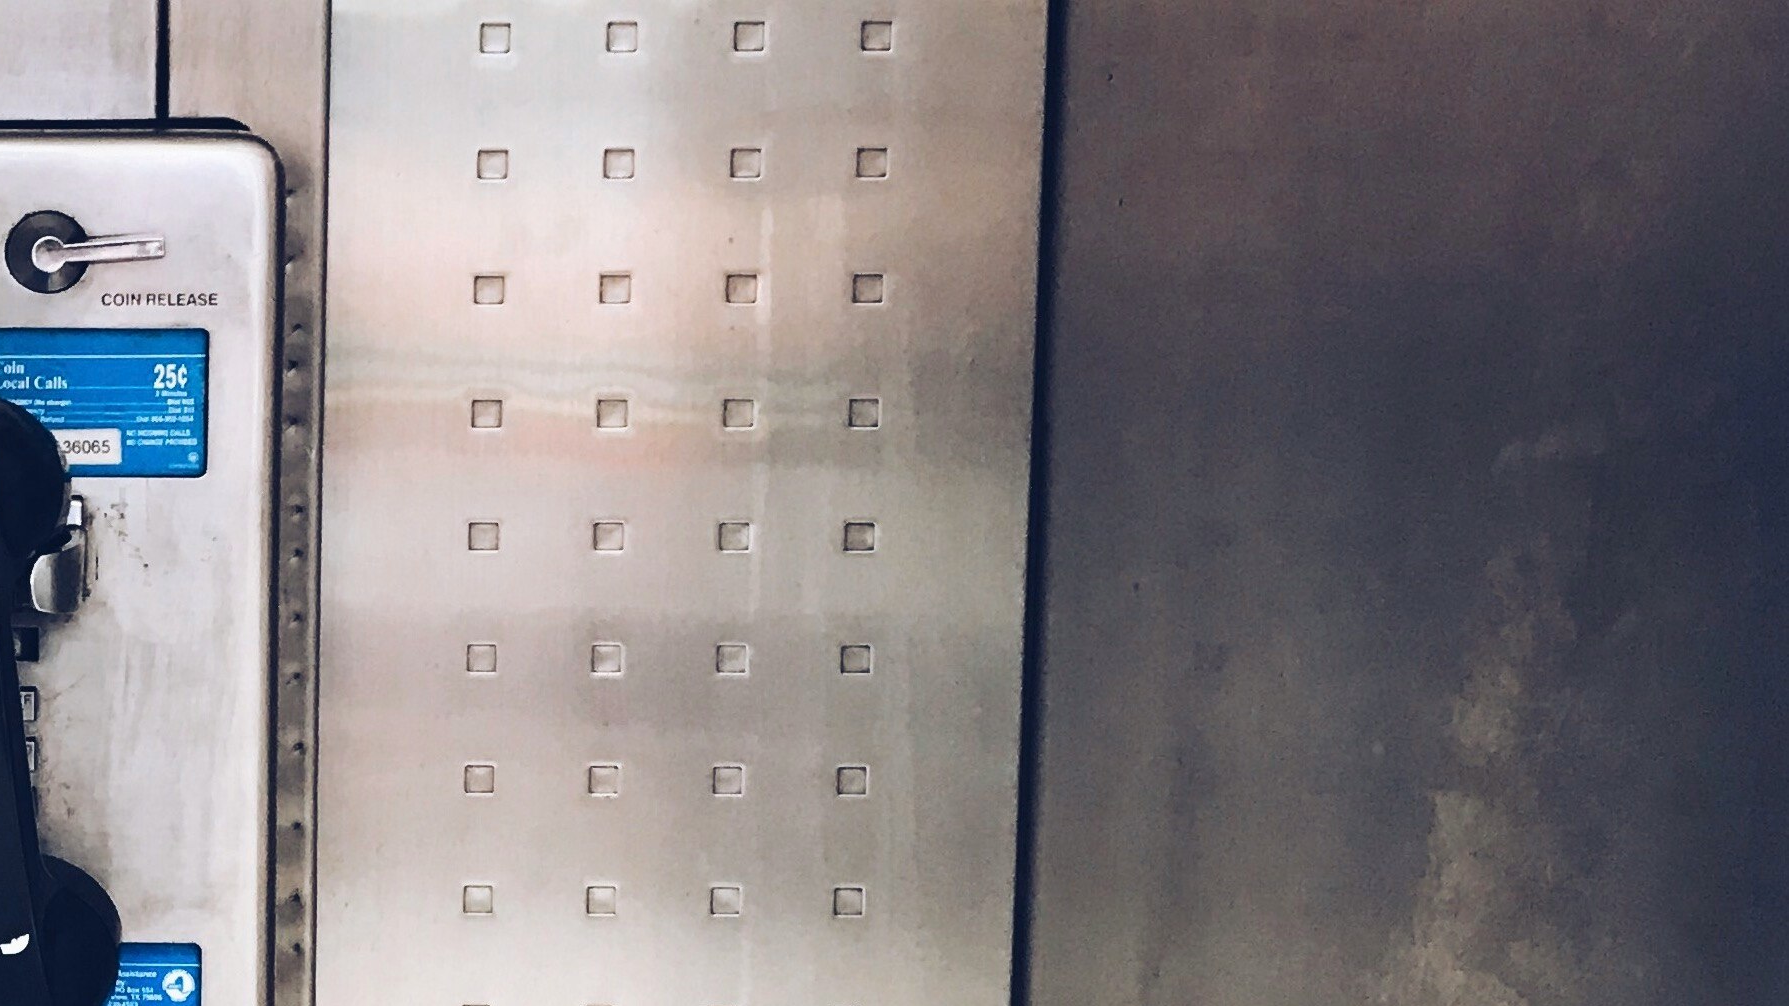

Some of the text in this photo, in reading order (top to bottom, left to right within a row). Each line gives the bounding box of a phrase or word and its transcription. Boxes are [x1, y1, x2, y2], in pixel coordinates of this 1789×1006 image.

[101, 293, 219, 306] COIN RELEASE
[34, 376, 68, 390] Calls
[153, 363, 188, 390] 25¢
